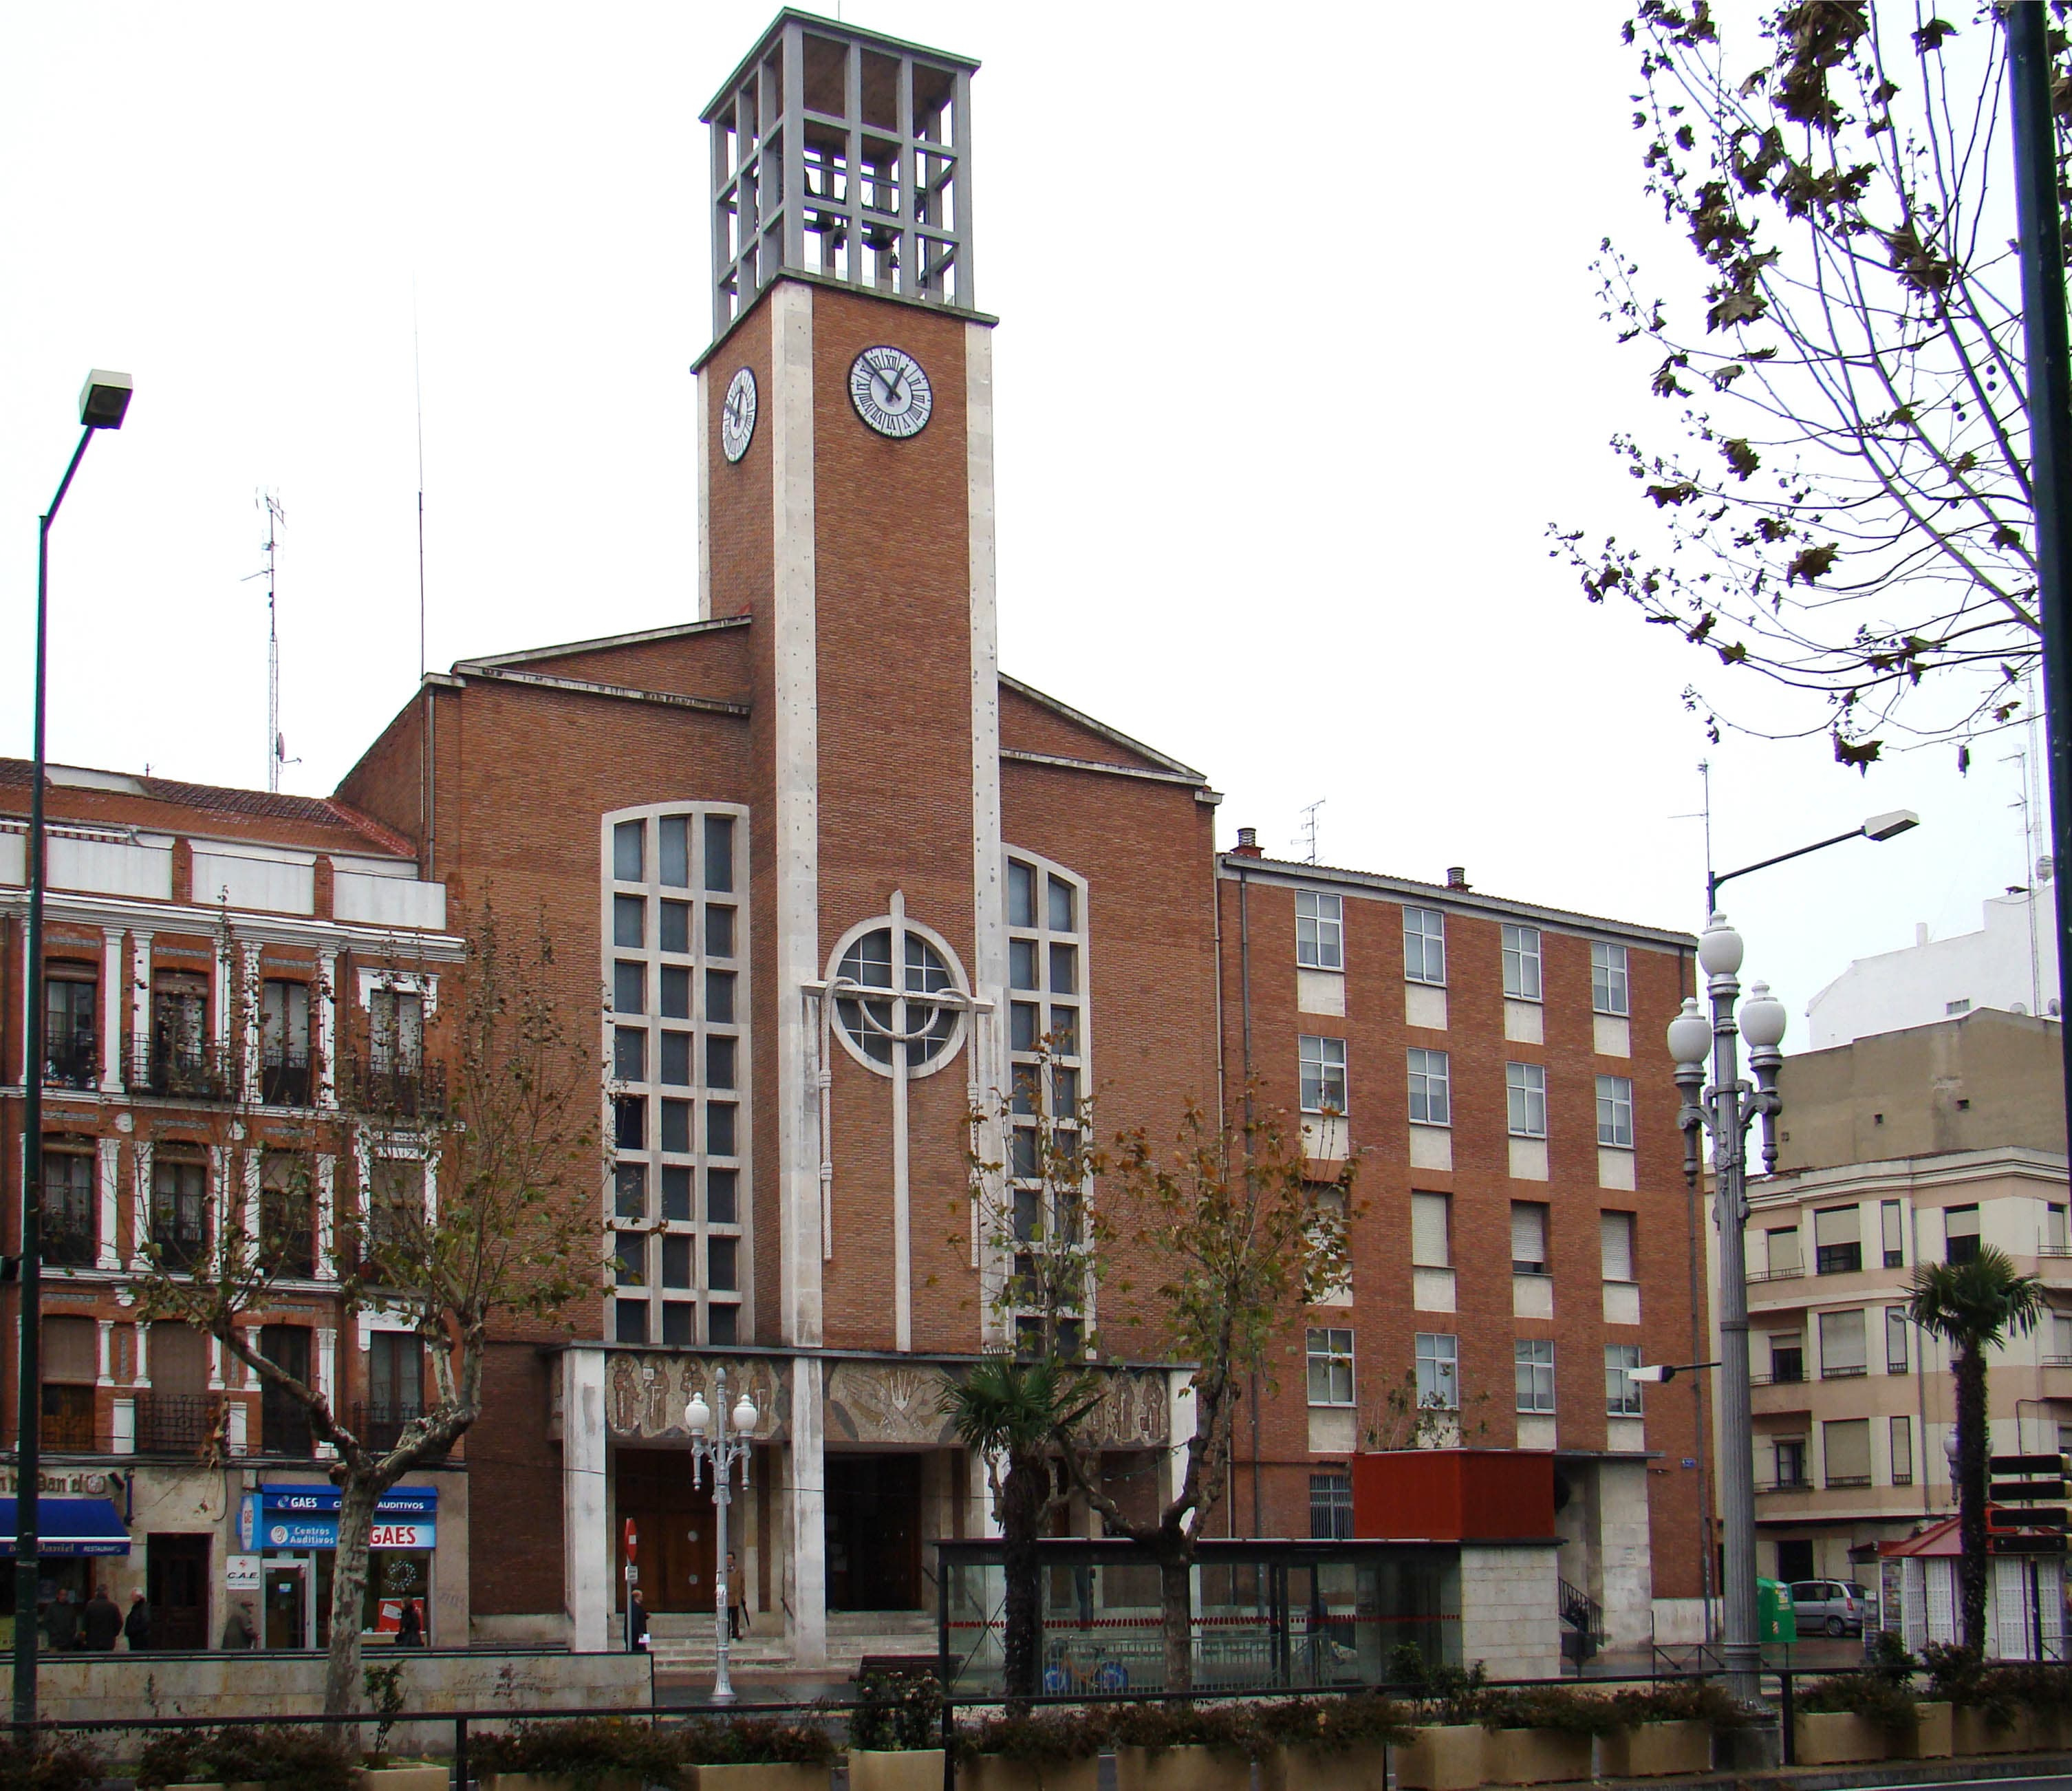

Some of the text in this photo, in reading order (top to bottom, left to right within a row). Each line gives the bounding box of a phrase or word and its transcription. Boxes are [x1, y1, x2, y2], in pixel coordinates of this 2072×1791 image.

[870, 355, 883, 369] XI
[885, 354, 897, 369] XII
[908, 378, 922, 386] II
[912, 394, 925, 405] III
[886, 416, 896, 431] VI
[901, 416, 911, 429] V
[291, 1497, 317, 1508] GAES
[378, 1501, 424, 1510] AUDITIVOS
[294, 1527, 330, 1535] Centros
[370, 1526, 416, 1545] GAES
[290, 1535, 334, 1544] Auditivos
